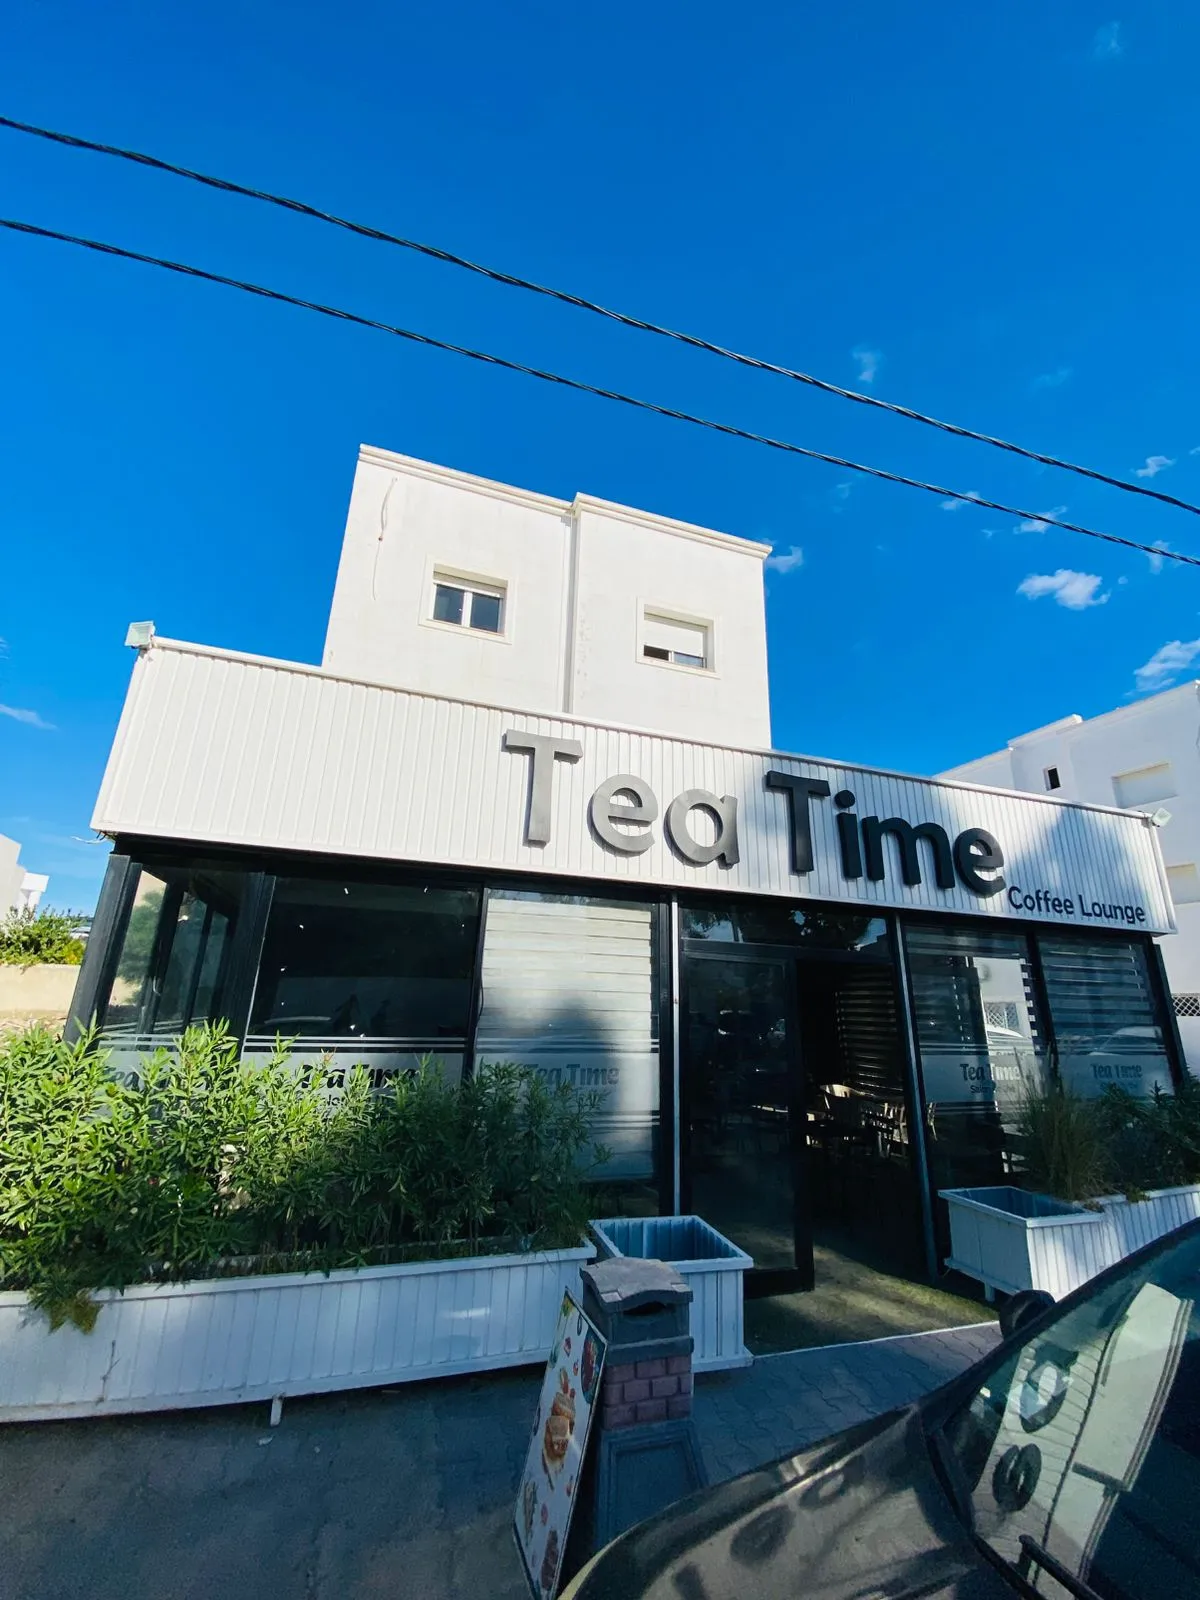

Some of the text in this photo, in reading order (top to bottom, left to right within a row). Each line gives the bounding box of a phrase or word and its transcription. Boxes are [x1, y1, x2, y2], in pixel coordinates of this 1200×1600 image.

[503, 729, 1006, 898] Tea Time
[1008, 886, 1146, 924] Coffee Lounge
[566, 1063, 620, 1086] Time
[959, 1063, 985, 1081] Tea
